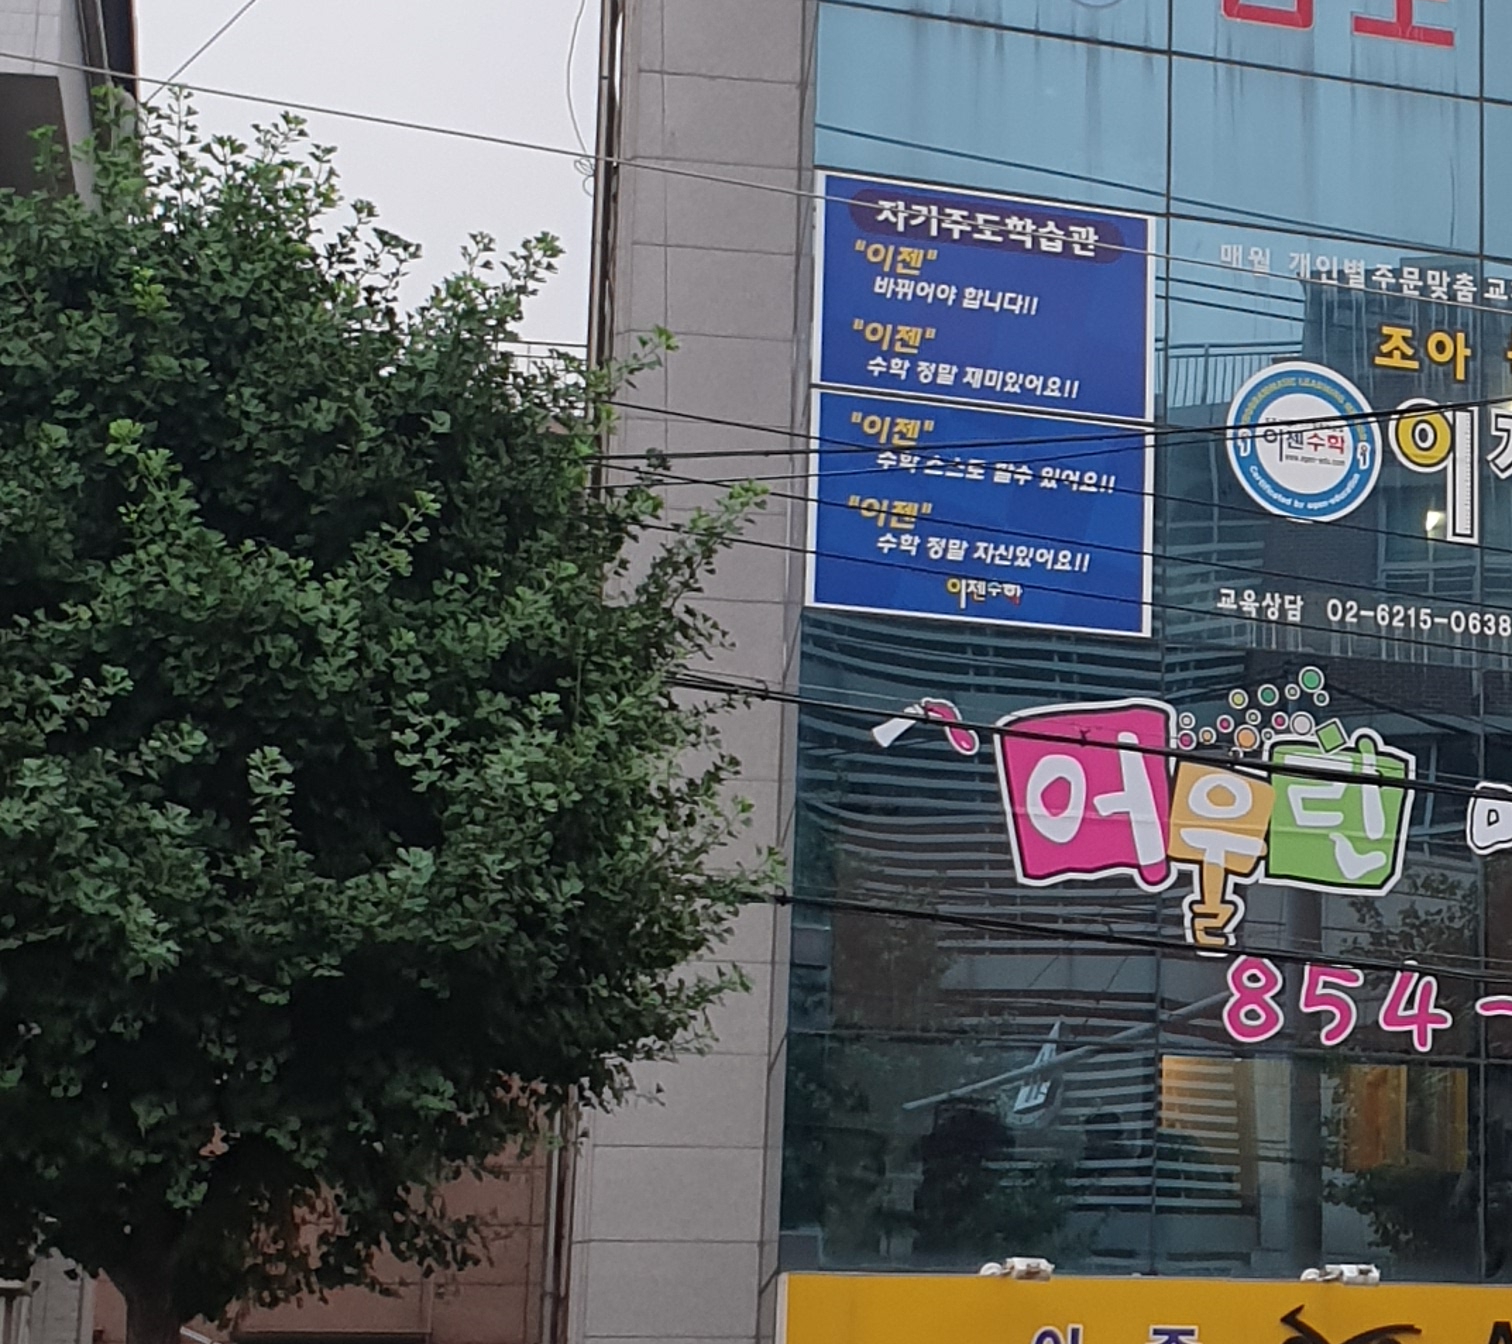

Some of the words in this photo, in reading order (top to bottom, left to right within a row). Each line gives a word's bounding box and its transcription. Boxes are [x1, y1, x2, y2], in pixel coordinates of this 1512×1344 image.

[876, 198, 1099, 256] 자기주도학습관
[1220, 244, 1271, 277] 매월
[874, 276, 957, 307] 바뀌어야
[962, 286, 1039, 316] 합니다!!
[1373, 324, 1472, 381] 조아
[866, 357, 910, 381] 수학
[916, 361, 958, 387] 정말
[961, 366, 1079, 400] 재미있어요!!
[876, 451, 921, 475] 수학
[876, 533, 921, 556] 수학
[926, 536, 969, 561] 정말
[972, 541, 1091, 573] 자신있어요!!
[1216, 587, 1305, 623] 교육상담
[1326, 598, 1512, 637] 02-6215-0638
